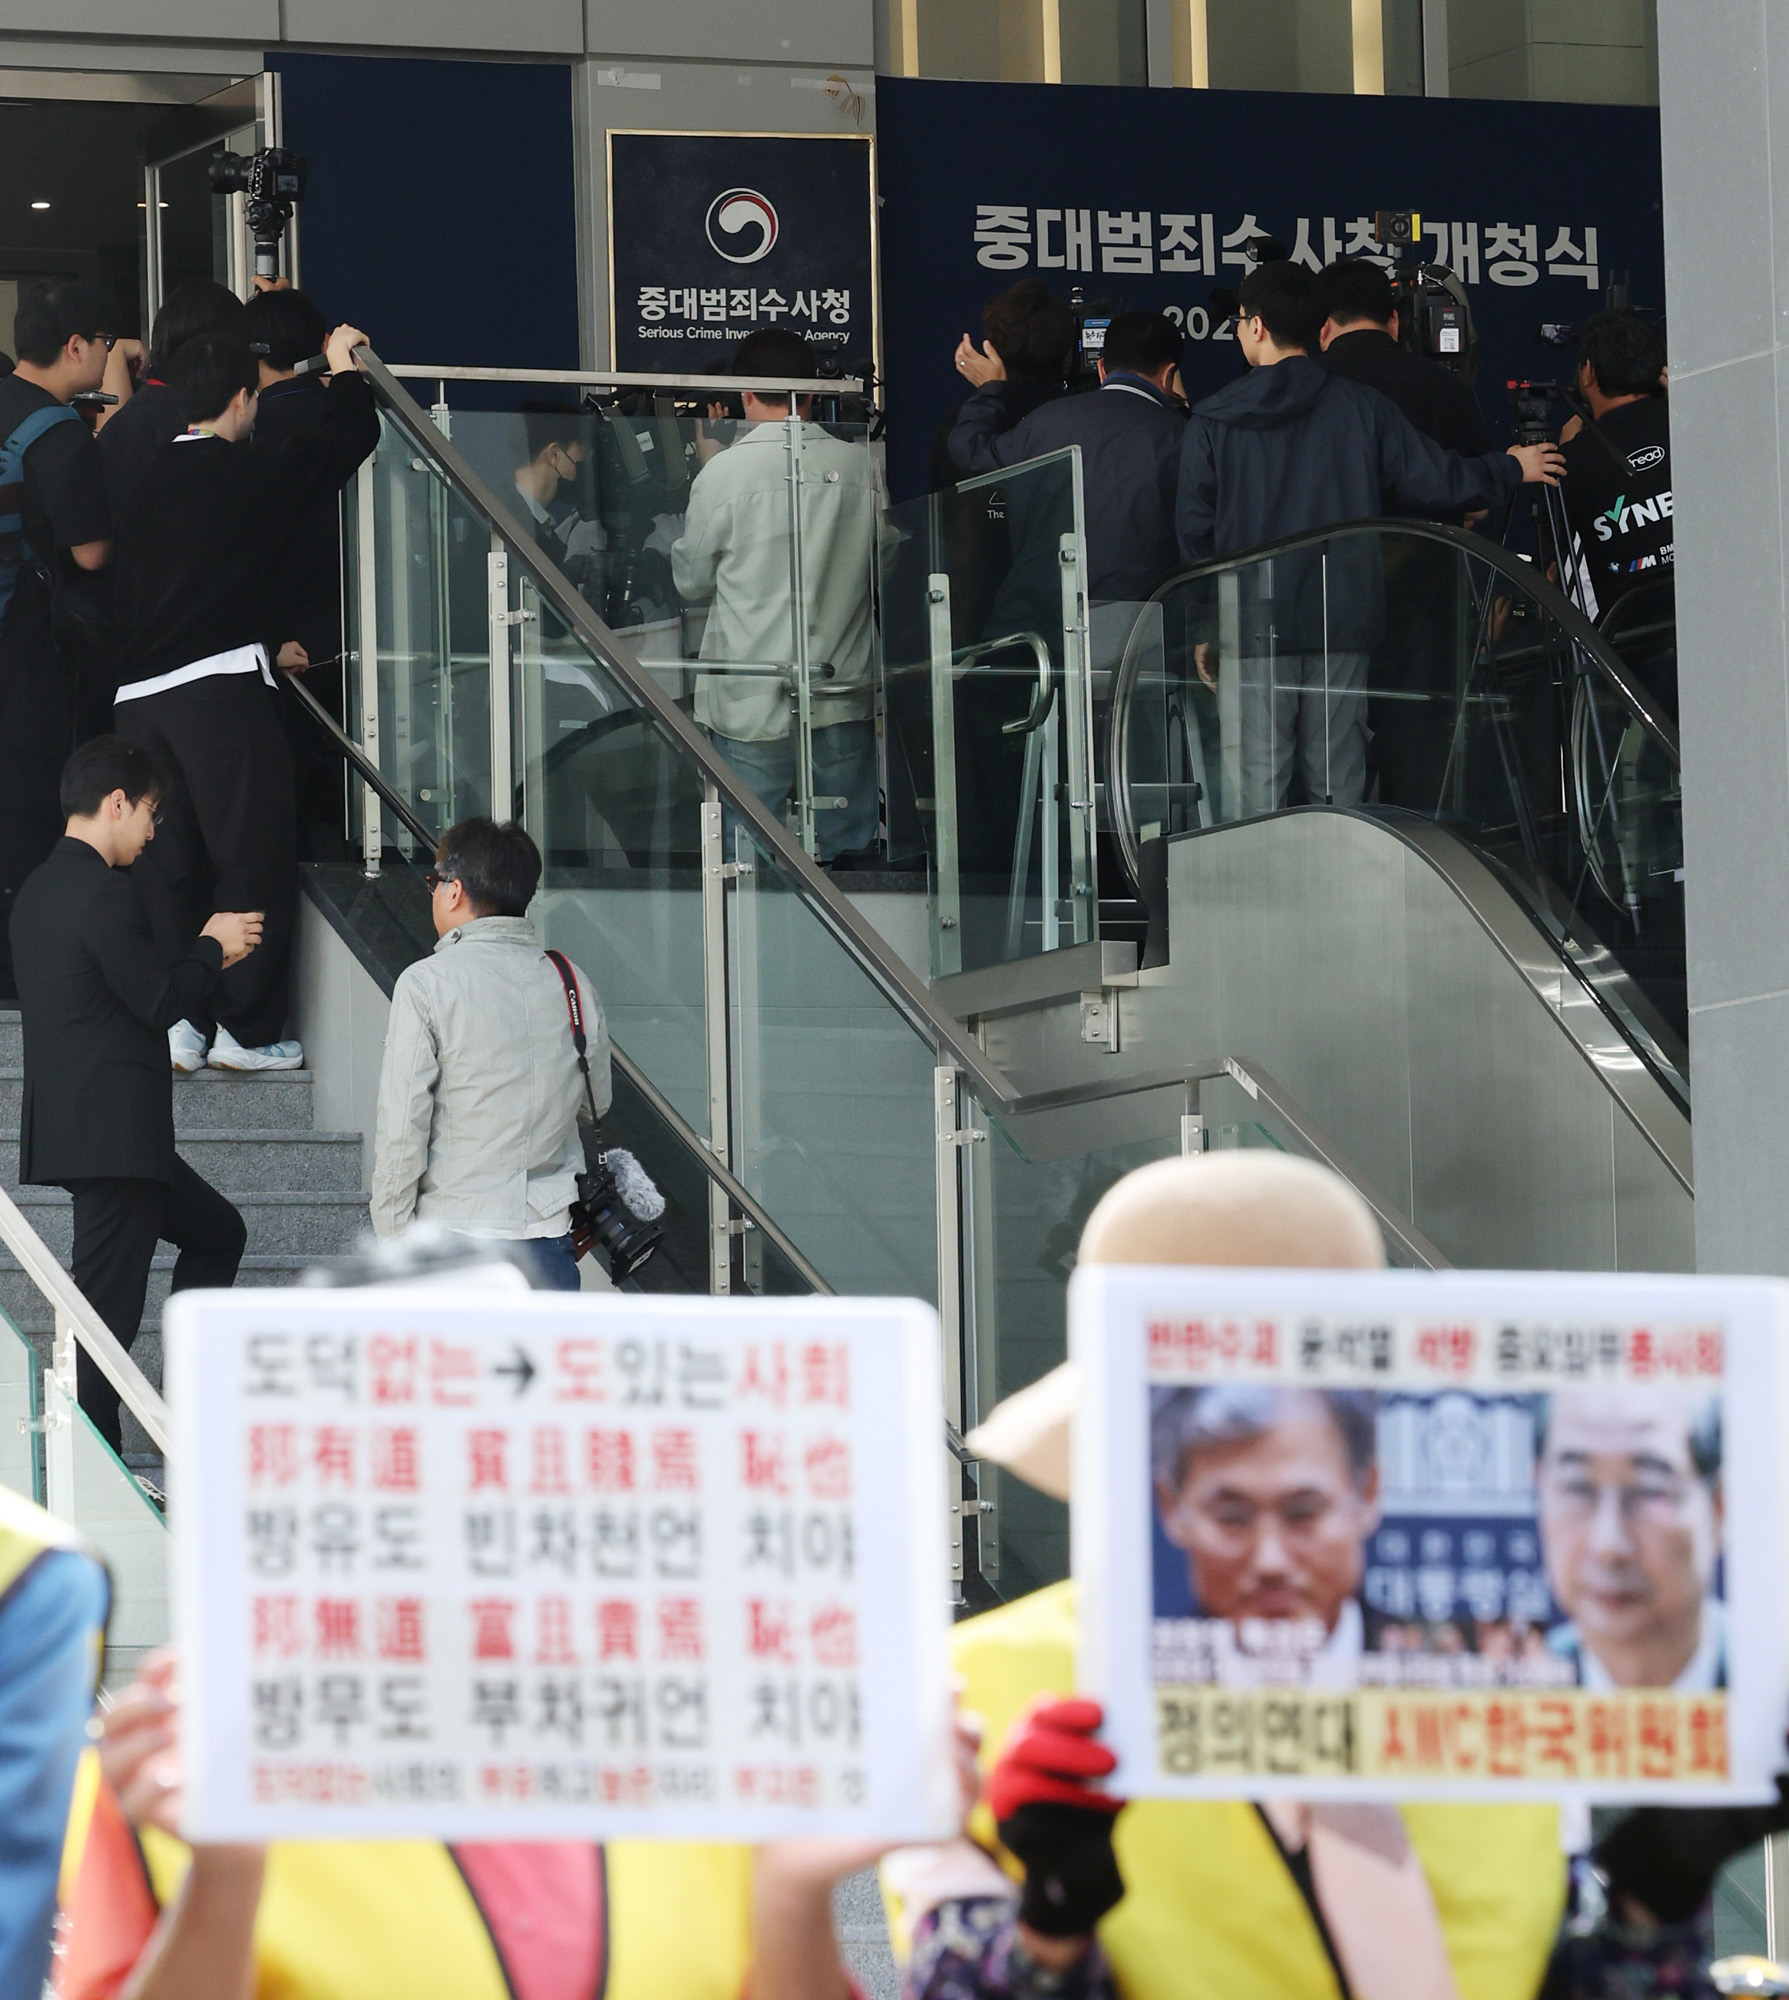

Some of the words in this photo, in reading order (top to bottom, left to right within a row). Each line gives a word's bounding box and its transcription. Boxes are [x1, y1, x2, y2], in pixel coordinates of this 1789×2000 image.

[1422, 221, 1599, 290] 개청식
[637, 286, 851, 325] 중대범죄수사청
[638, 326, 684, 339] Serious
[686, 326, 722, 340] Crime
[804, 328, 851, 344] Agency
[987, 509, 1005, 519] The
[569, 989, 580, 1026] Canon
[246, 1333, 478, 1406] 도덕없는
[1297, 1321, 1394, 1375] 윤석열
[1413, 1321, 1478, 1376] 석방
[247, 1506, 424, 1578] 방유도
[465, 1507, 703, 1579] 빈차천언
[743, 1508, 856, 1581] 치야
[251, 1679, 431, 1753] 방무도
[472, 1678, 710, 1754] 부차귀언
[750, 1680, 864, 1756] 치야
[1158, 1698, 1358, 1776] 정의연대
